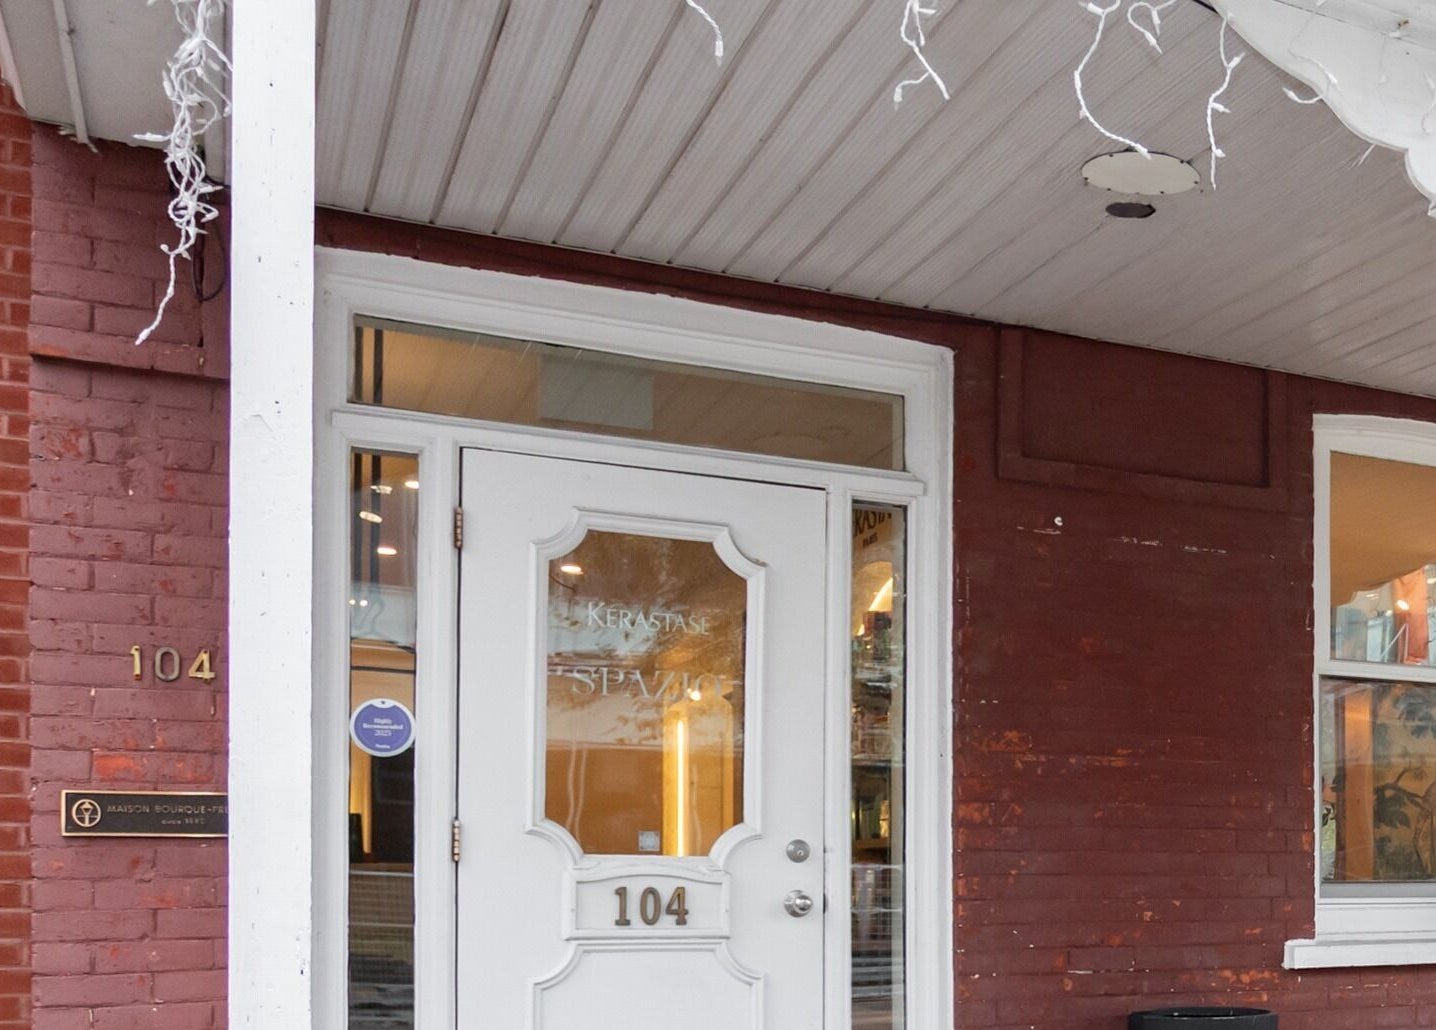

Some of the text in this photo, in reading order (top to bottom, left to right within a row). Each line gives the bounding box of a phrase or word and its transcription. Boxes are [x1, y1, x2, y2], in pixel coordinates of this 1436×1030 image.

[129, 645, 216, 684] 104
[106, 805, 149, 814] MAISON
[614, 886, 689, 926] 104
